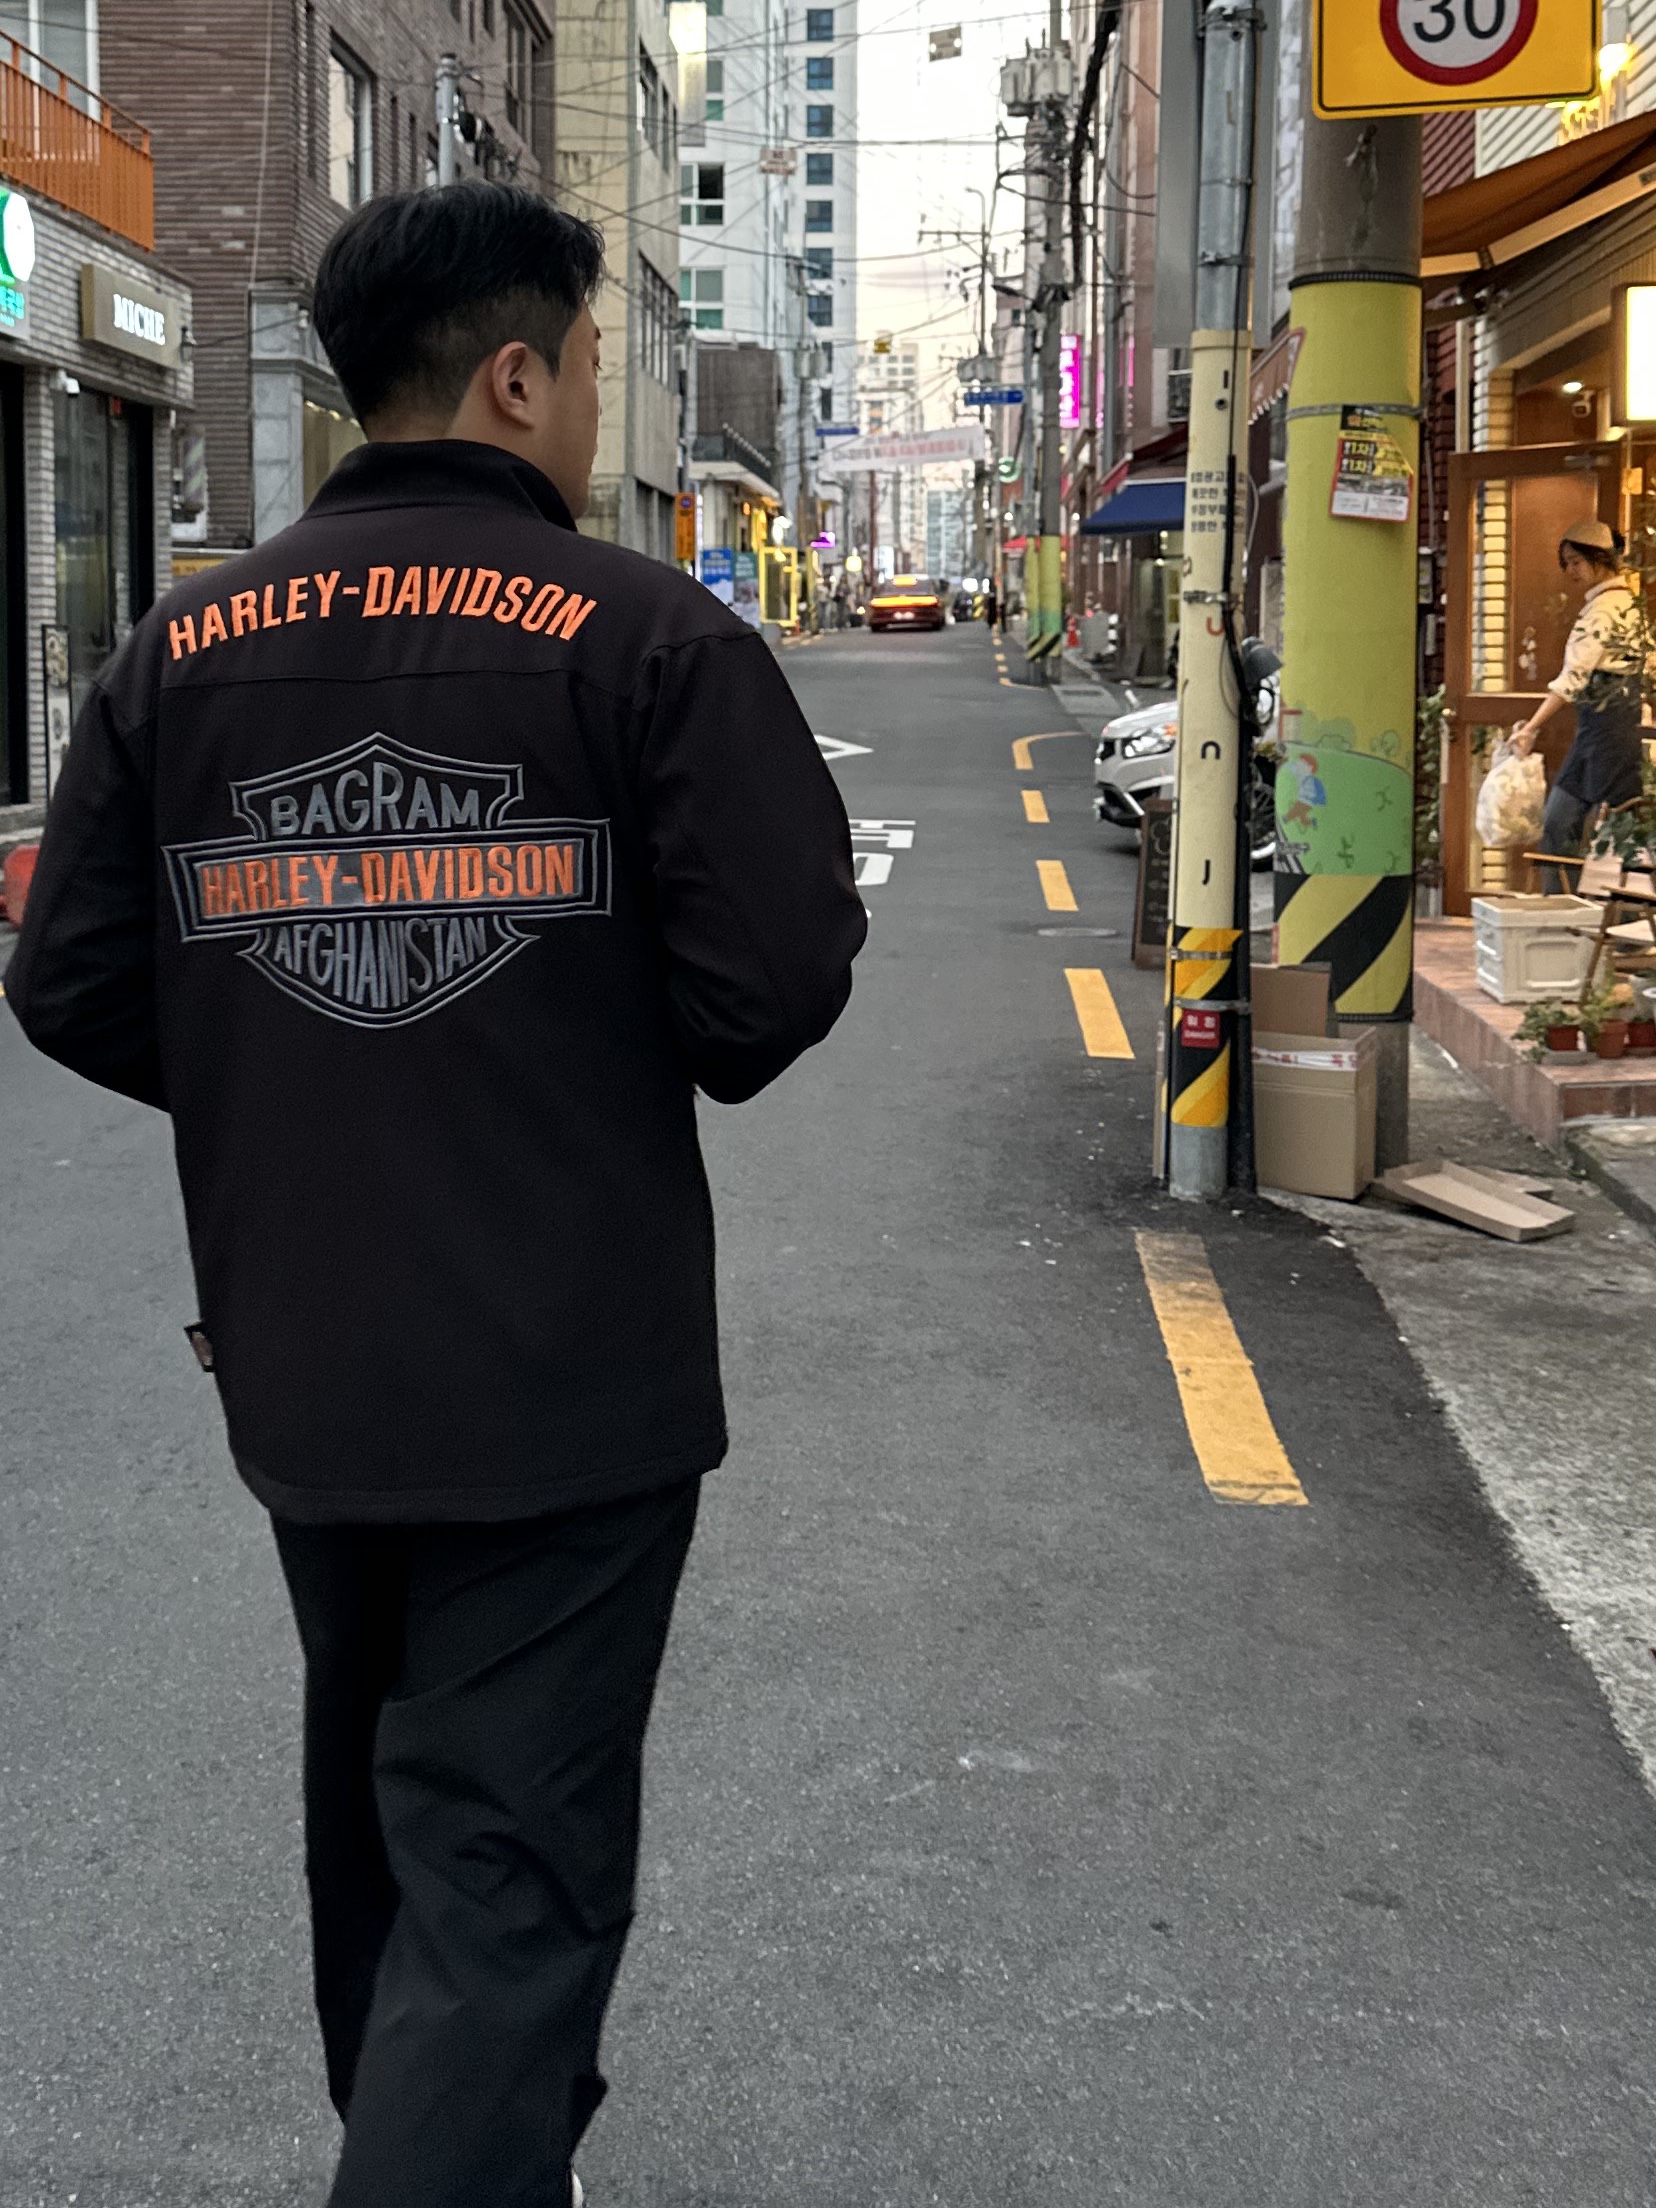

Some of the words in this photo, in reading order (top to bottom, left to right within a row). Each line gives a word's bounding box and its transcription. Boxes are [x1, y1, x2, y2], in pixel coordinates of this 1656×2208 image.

[1413, 0, 1505, 43] 30
[168, 565, 598, 661] HARLEY-DAVIDSON
[270, 761, 480, 836] BAGRAM
[202, 844, 576, 917] HARLEY-DAVIDSON
[273, 916, 488, 1009] AFGHANISTAN
